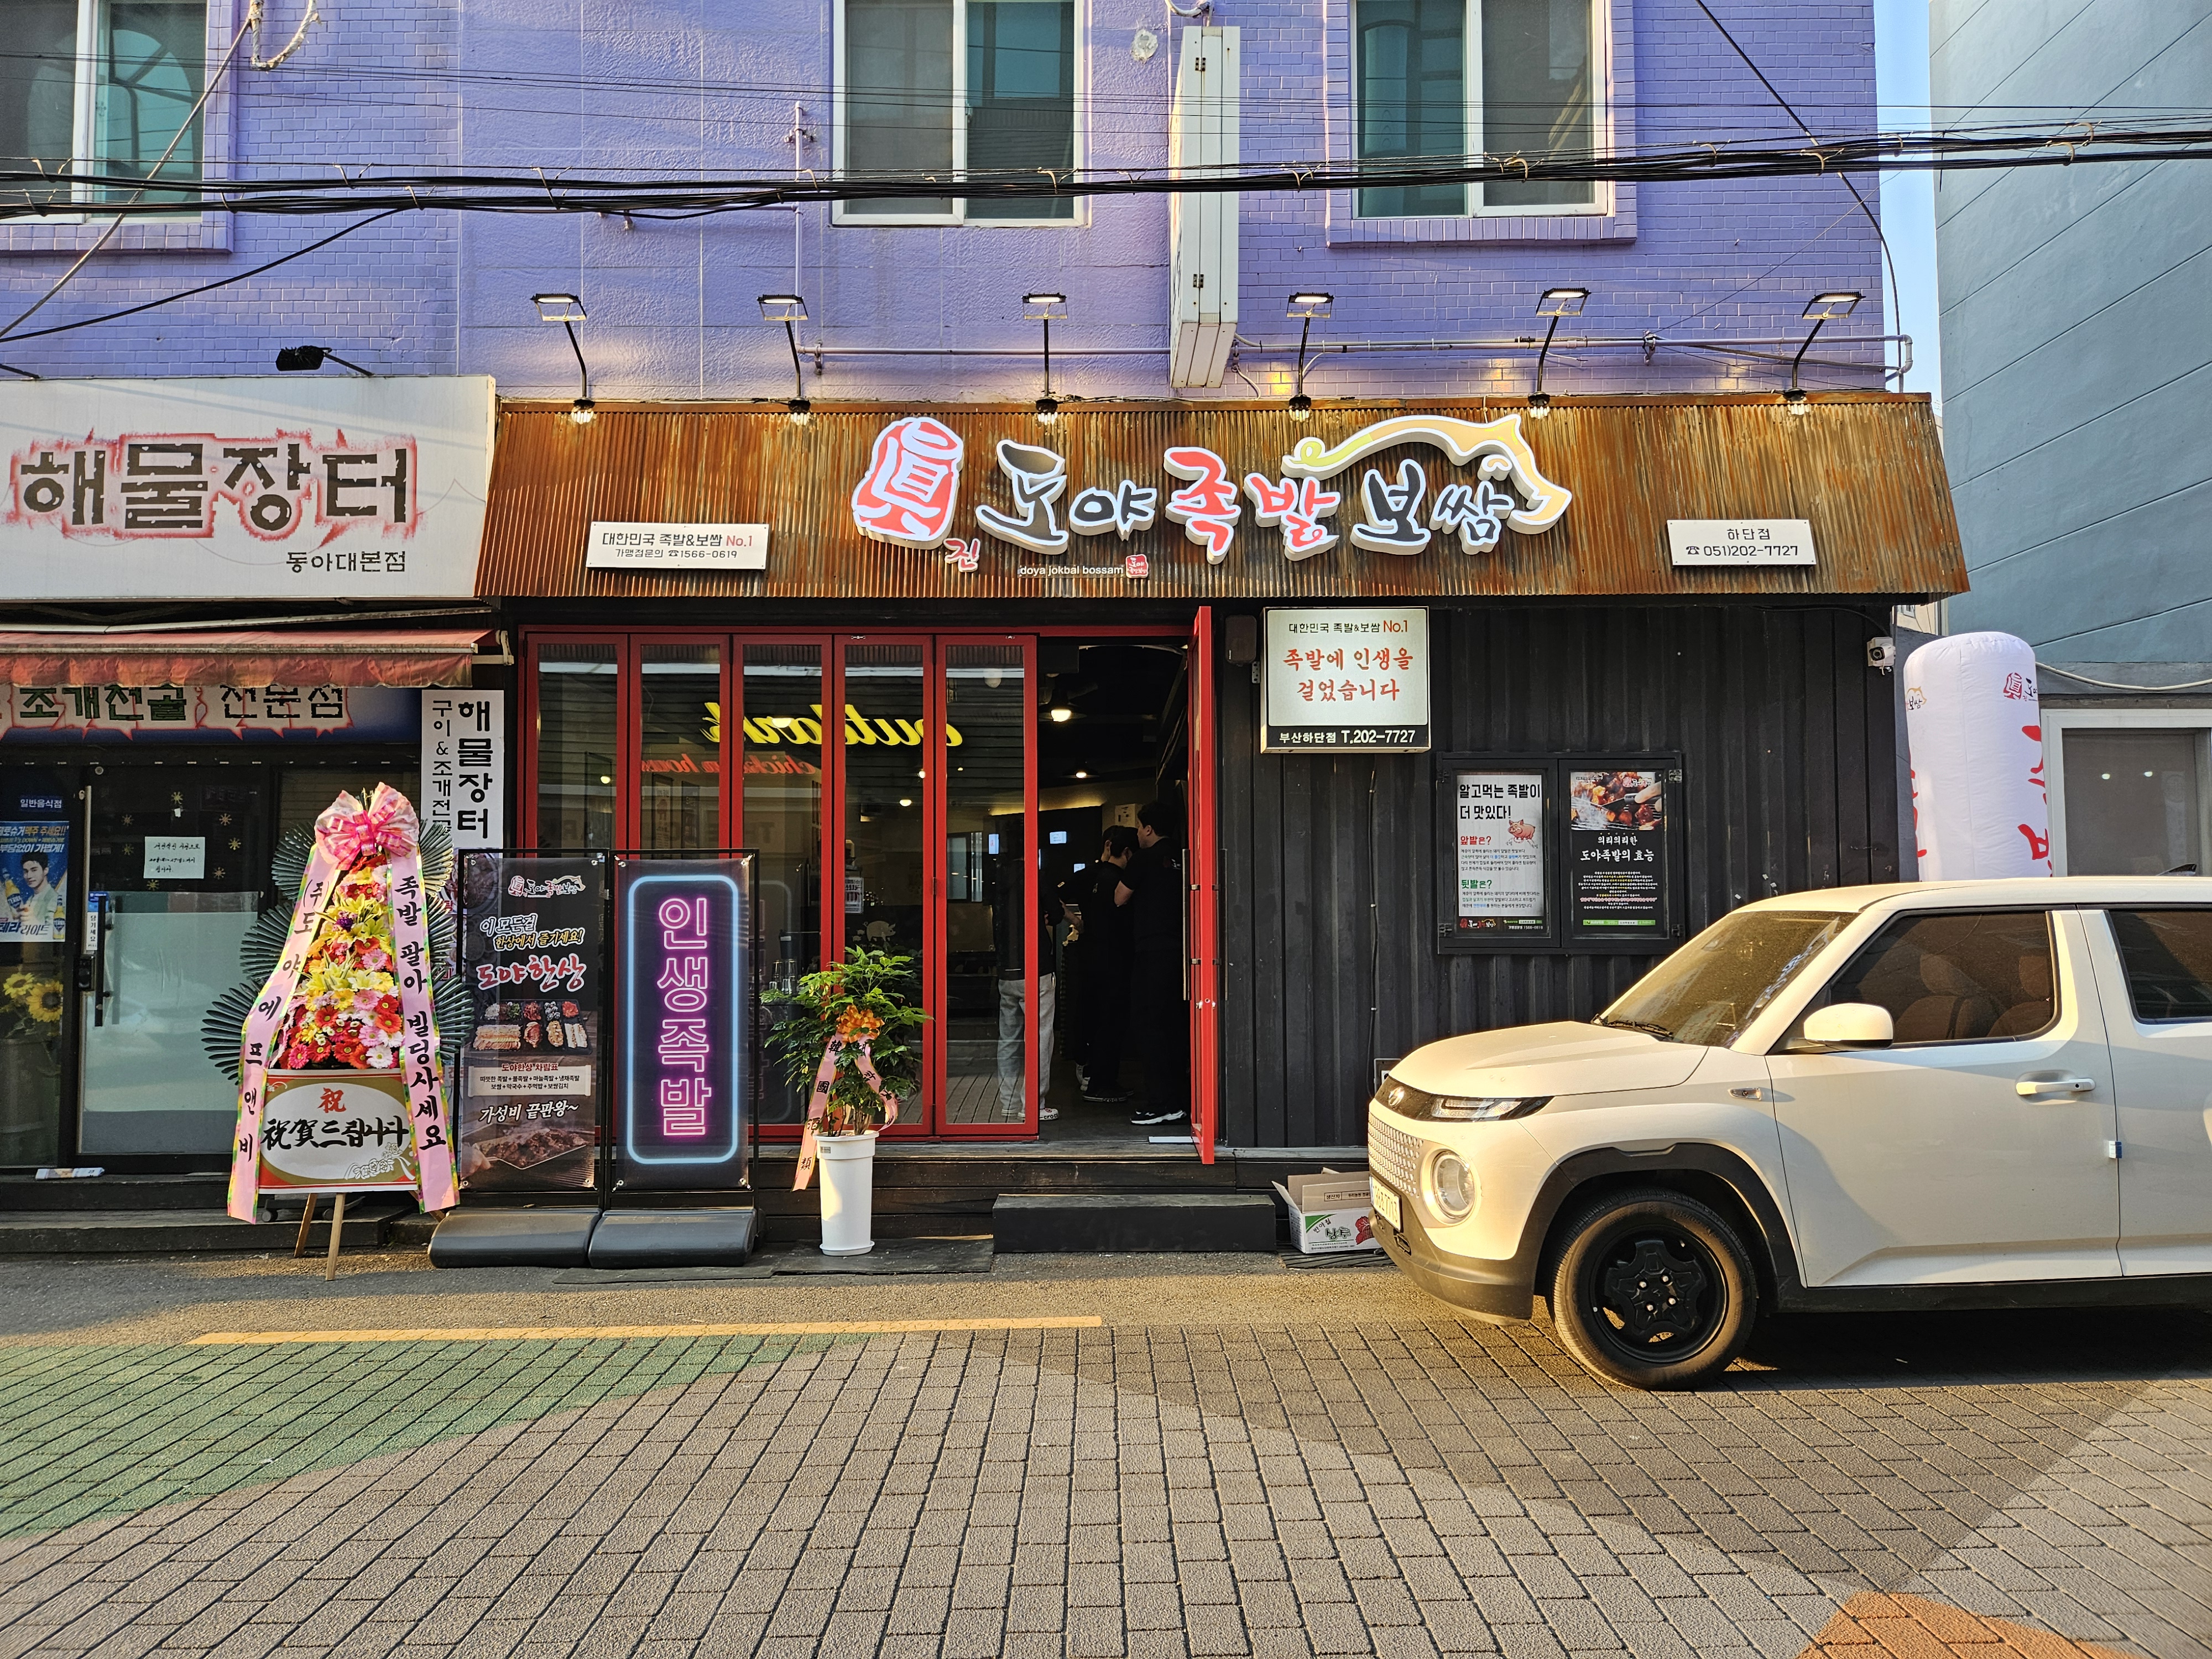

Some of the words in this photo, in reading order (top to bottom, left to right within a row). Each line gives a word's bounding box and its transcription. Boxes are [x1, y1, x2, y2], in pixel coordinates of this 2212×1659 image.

[20, 444, 406, 531] 해물장터
[1164, 447, 1340, 561] 족발
[1353, 460, 1514, 552] 보쌈
[602, 533, 655, 546] 대한민국
[659, 534, 723, 546] 족발&보쌈
[726, 535, 753, 547] No.1
[1727, 528, 1770, 540] 하단점
[615, 549, 664, 558] 가맹점문의
[681, 550, 737, 559] 1566-0619
[943, 538, 980, 572] 진
[1703, 545, 1798, 556] 051)202-7727
[286, 551, 406, 573] 동아대본점
[1020, 566, 1046, 576] doya
[1048, 565, 1079, 576] jokbal
[1082, 565, 1124, 575] bossam
[1289, 623, 1329, 633] 대한민국
[1333, 623, 1380, 633] 족발&보쌈
[1383, 620, 1408, 633] No.1
[1283, 648, 1344, 671] 족발에
[1354, 647, 1413, 671] 인생을
[1297, 679, 1400, 702] 걸었습니다
[19, 686, 186, 721] 조개전골
[1279, 732, 1337, 744] 부산하단점
[1340, 730, 1416, 744] T.202-7727
[457, 701, 493, 839] 해물장터
[1459, 784, 1504, 799] 알고먹는
[1507, 784, 1540, 799] 족발이
[20, 799, 62, 808] 일반음식점
[1460, 805, 1470, 819] 더
[1474, 805, 1511, 820] 맛있다!
[0, 843, 34, 853] 부담없이
[34, 843, 65, 853] 가볍게!
[1460, 836, 1491, 846] 앞발은?
[1598, 836, 1638, 846] 의리의리한
[1580, 849, 1630, 862] 도야족발의
[1633, 849, 1655, 862] 효능
[1461, 879, 1492, 889] 뒷발은?
[394, 876, 422, 927] 족발
[20, 925, 50, 936] 라이트
[480, 917, 496, 937] 이
[497, 913, 538, 934] 모든걸
[494, 933, 536, 950] 한상에서
[538, 928, 585, 947] 즐기세요!
[399, 941, 427, 995] 팔아
[477, 953, 586, 992] 도야한상
[657, 898, 712, 1136] 인생족발
[501, 1062, 533, 1072] 도야한상
[535, 1063, 559, 1072] 차림표
[405, 1013, 447, 1152] 빌딩사세요
[317, 1087, 347, 1113] 祝
[478, 1104, 522, 1124] 가성비
